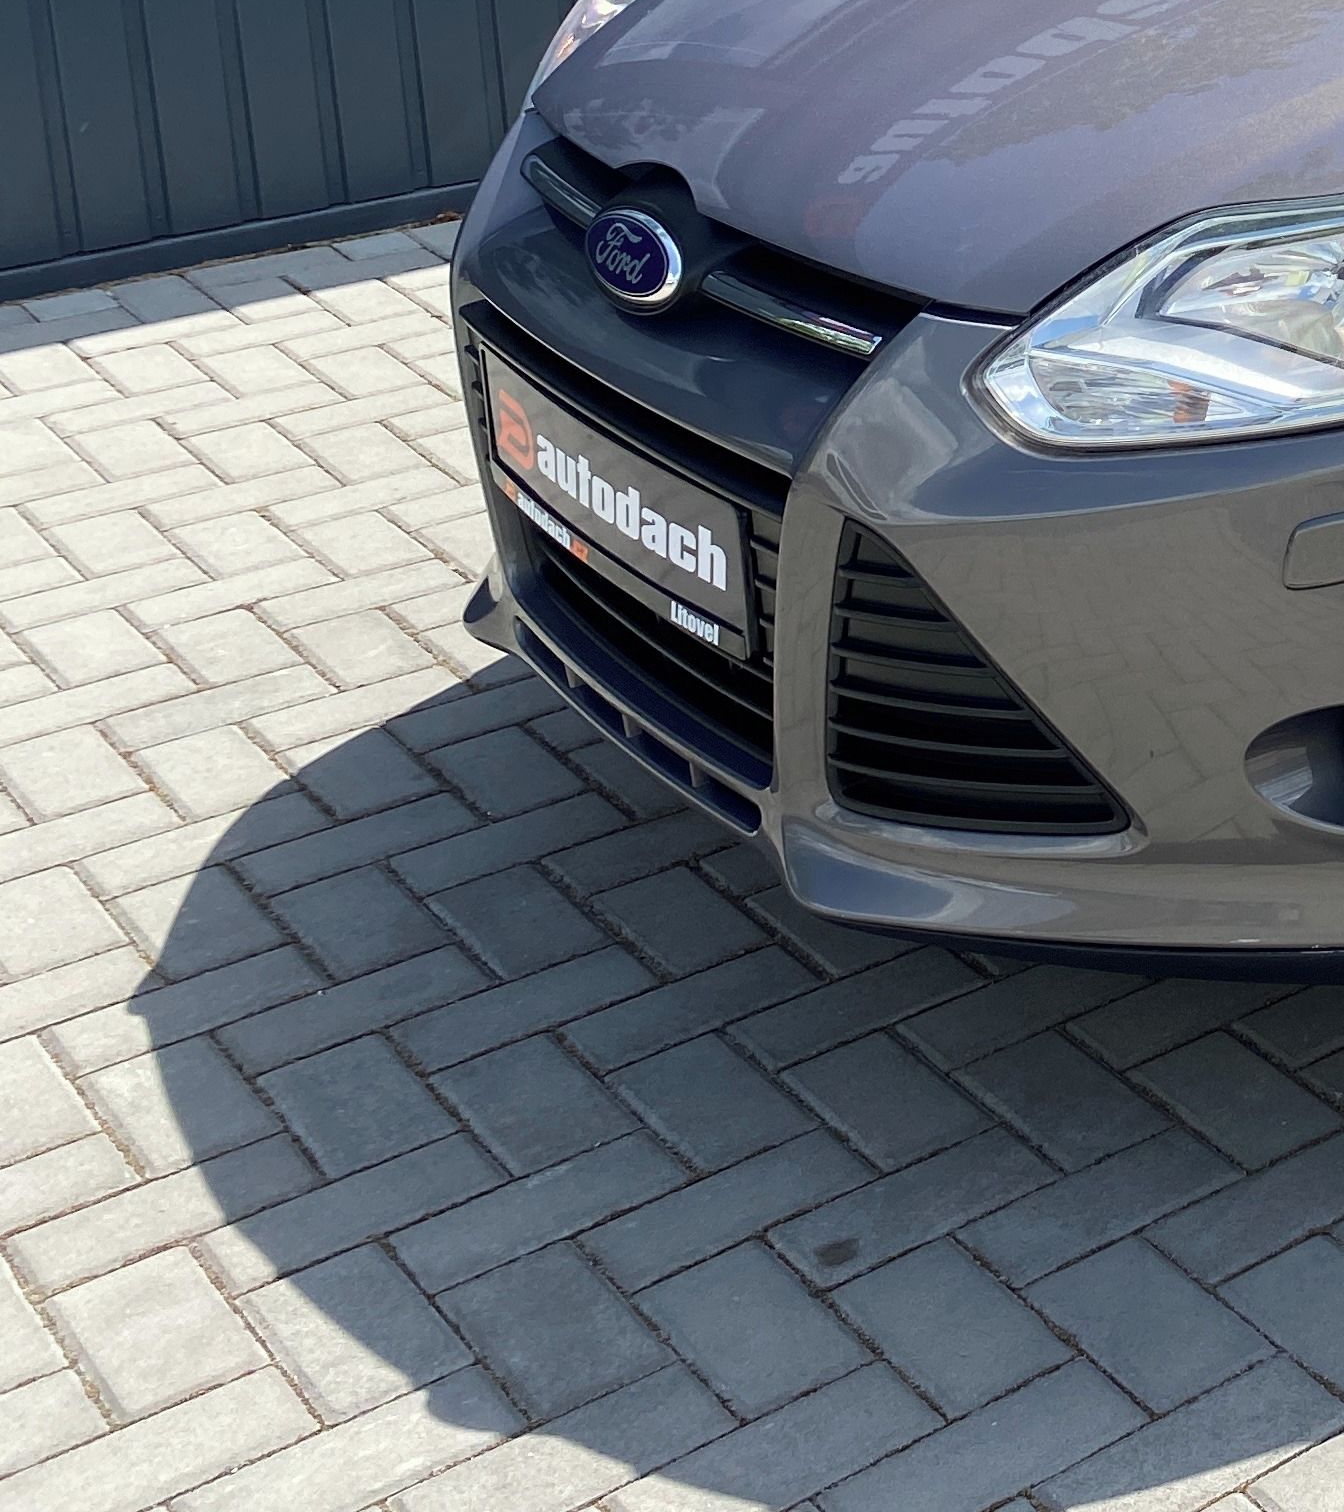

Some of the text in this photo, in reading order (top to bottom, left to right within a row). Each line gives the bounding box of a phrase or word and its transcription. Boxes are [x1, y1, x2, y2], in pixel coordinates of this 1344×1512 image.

[596, 221, 647, 285] Ford
[536, 433, 727, 591] autodach
[670, 600, 720, 646] Litovel
